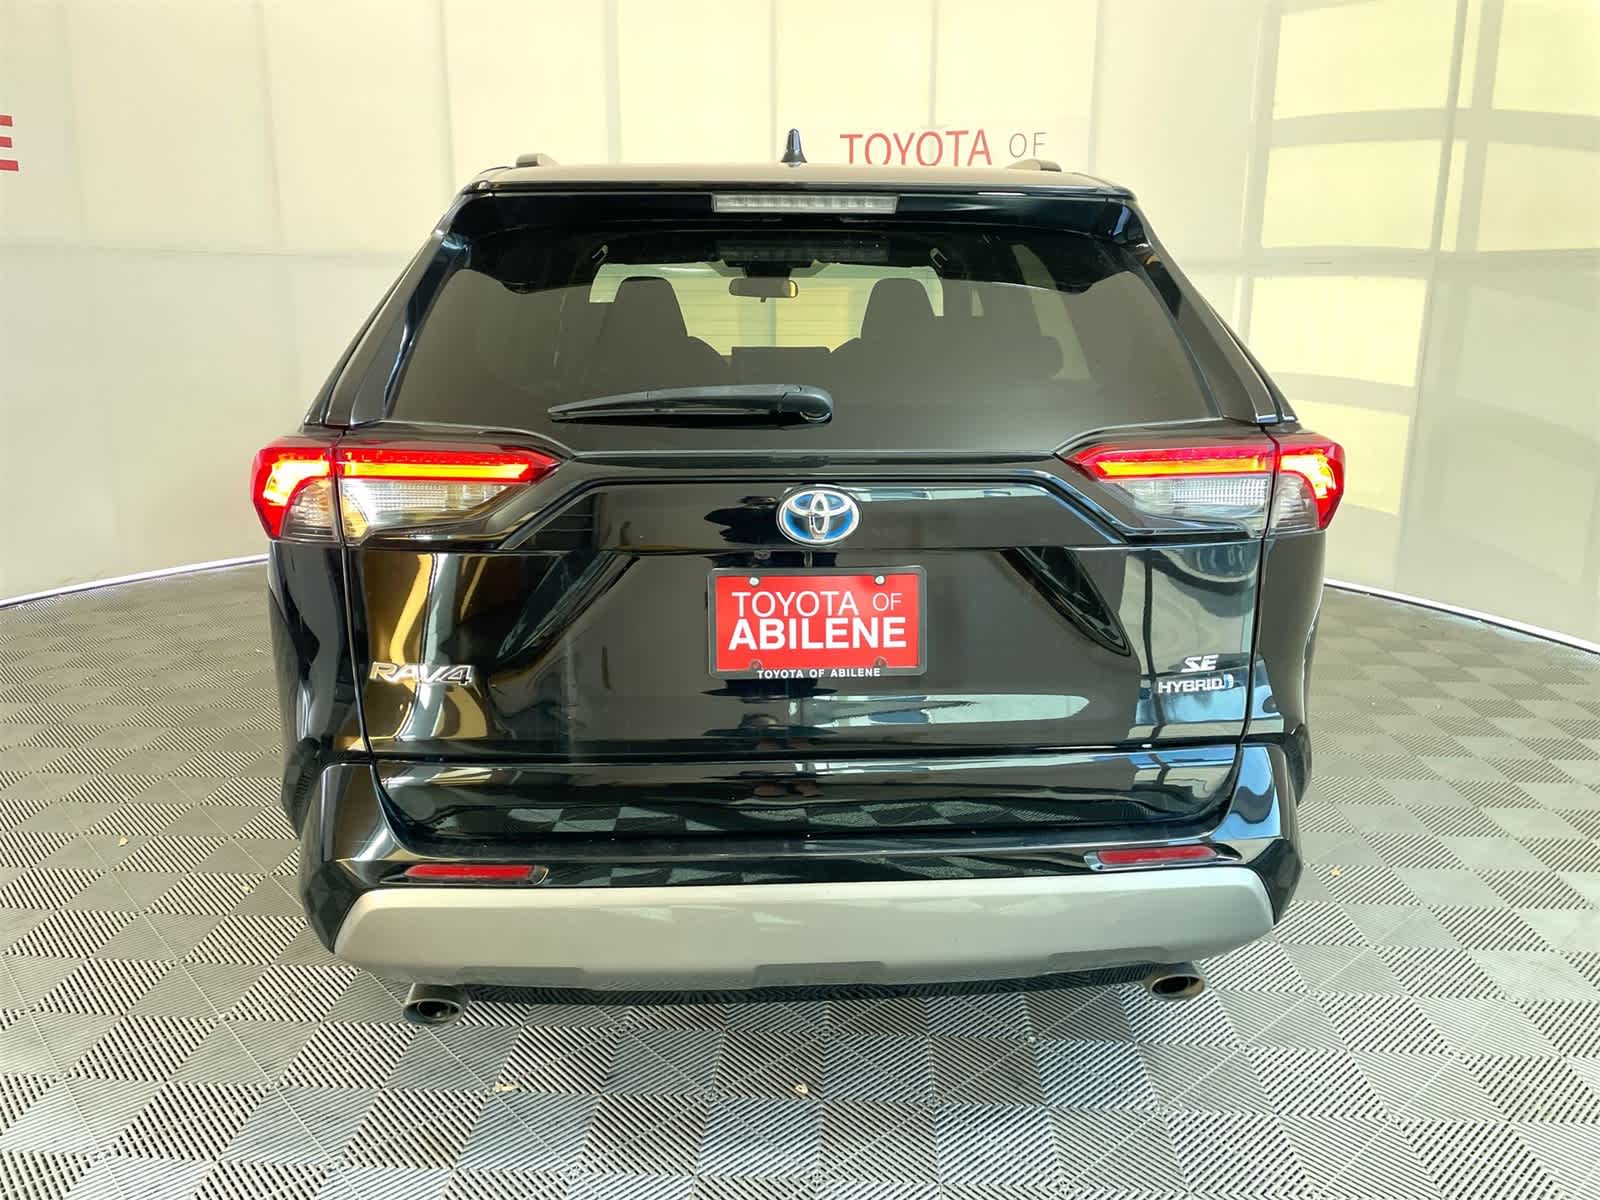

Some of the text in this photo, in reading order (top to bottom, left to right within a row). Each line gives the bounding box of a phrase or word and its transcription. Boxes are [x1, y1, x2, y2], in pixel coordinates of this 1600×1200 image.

[839, 129, 1047, 167] TOYOTA OF
[731, 591, 902, 617] TOYOTA OF
[728, 617, 907, 650] ABILENE
[369, 662, 473, 686] RAV4
[757, 668, 881, 679] TOYOTA OF ABILENE
[1181, 654, 1219, 672] SE
[1158, 676, 1224, 694] HYBRID
